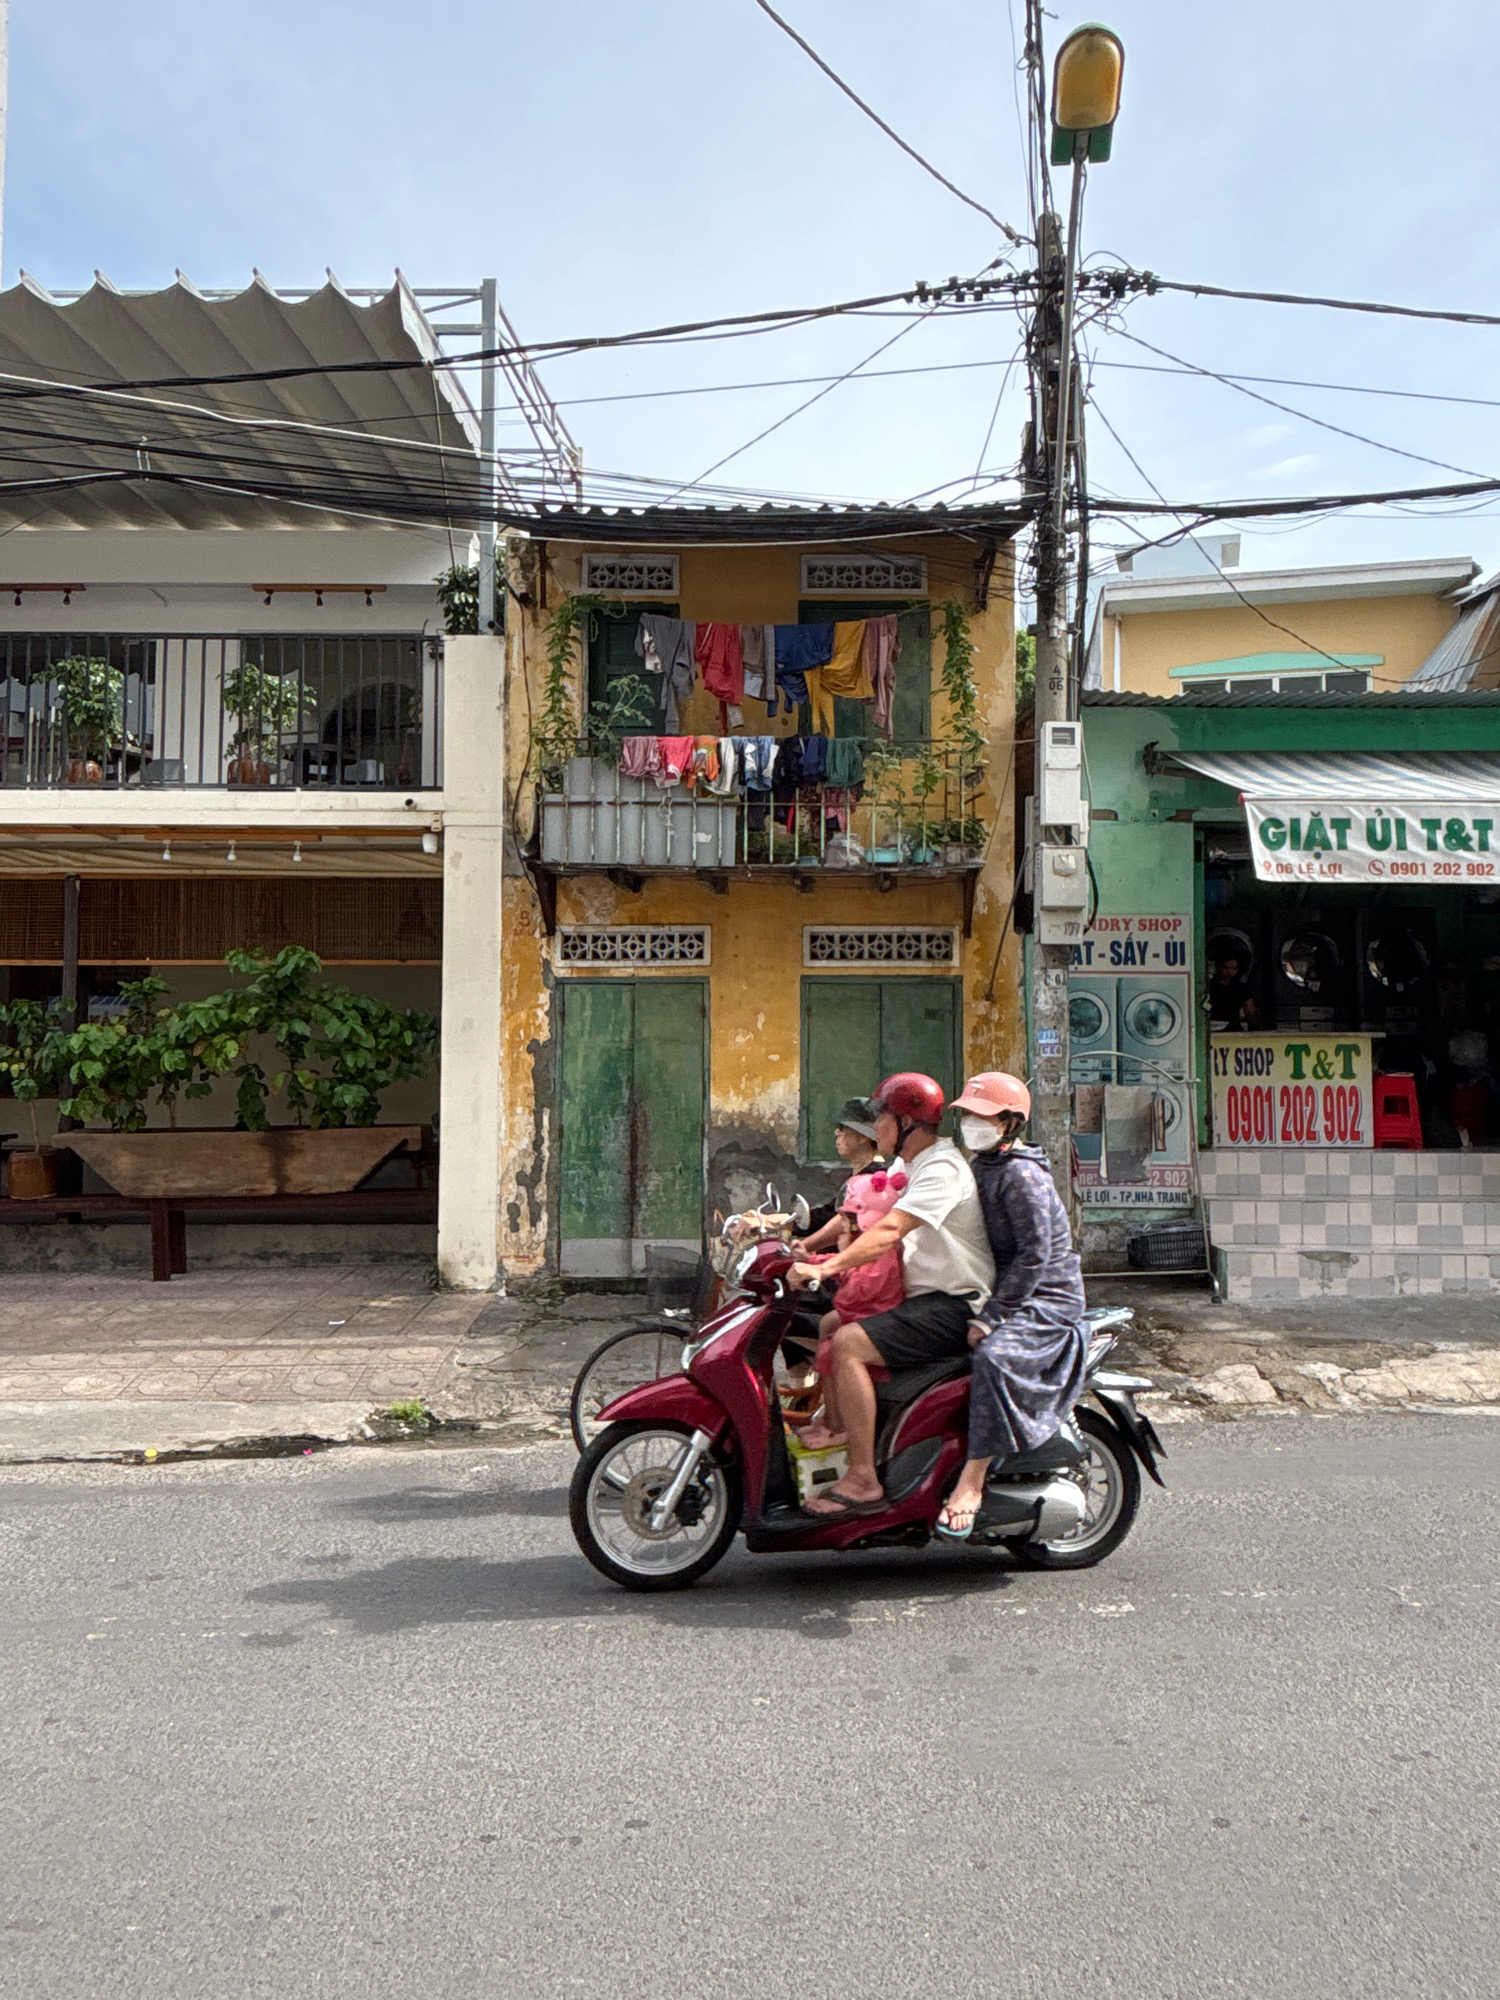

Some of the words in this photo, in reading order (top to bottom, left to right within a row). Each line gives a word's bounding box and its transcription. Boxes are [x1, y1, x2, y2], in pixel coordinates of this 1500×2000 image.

[1048, 680, 1064, 691] 06
[1258, 811, 1352, 860] GIẶT
[1366, 808, 1408, 851] ỦI
[1420, 817, 1494, 852] T&T
[1275, 863, 1293, 875] 06
[1298, 861, 1315, 875] LÊ
[1390, 862, 1427, 876] 0901
[1433, 862, 1462, 876] 202
[1466, 863, 1495, 876] 902
[1137, 918, 1182, 932] SHOP
[1109, 932, 1149, 966] SẤY
[1164, 934, 1186, 967] ỦI
[1234, 1047, 1274, 1077] SHOP
[1284, 1043, 1361, 1080] T&T
[1227, 1085, 1275, 1143] 0901
[1280, 1085, 1318, 1143] 202
[1323, 1085, 1363, 1143] 902
[1164, 1170, 1188, 1187] 902
